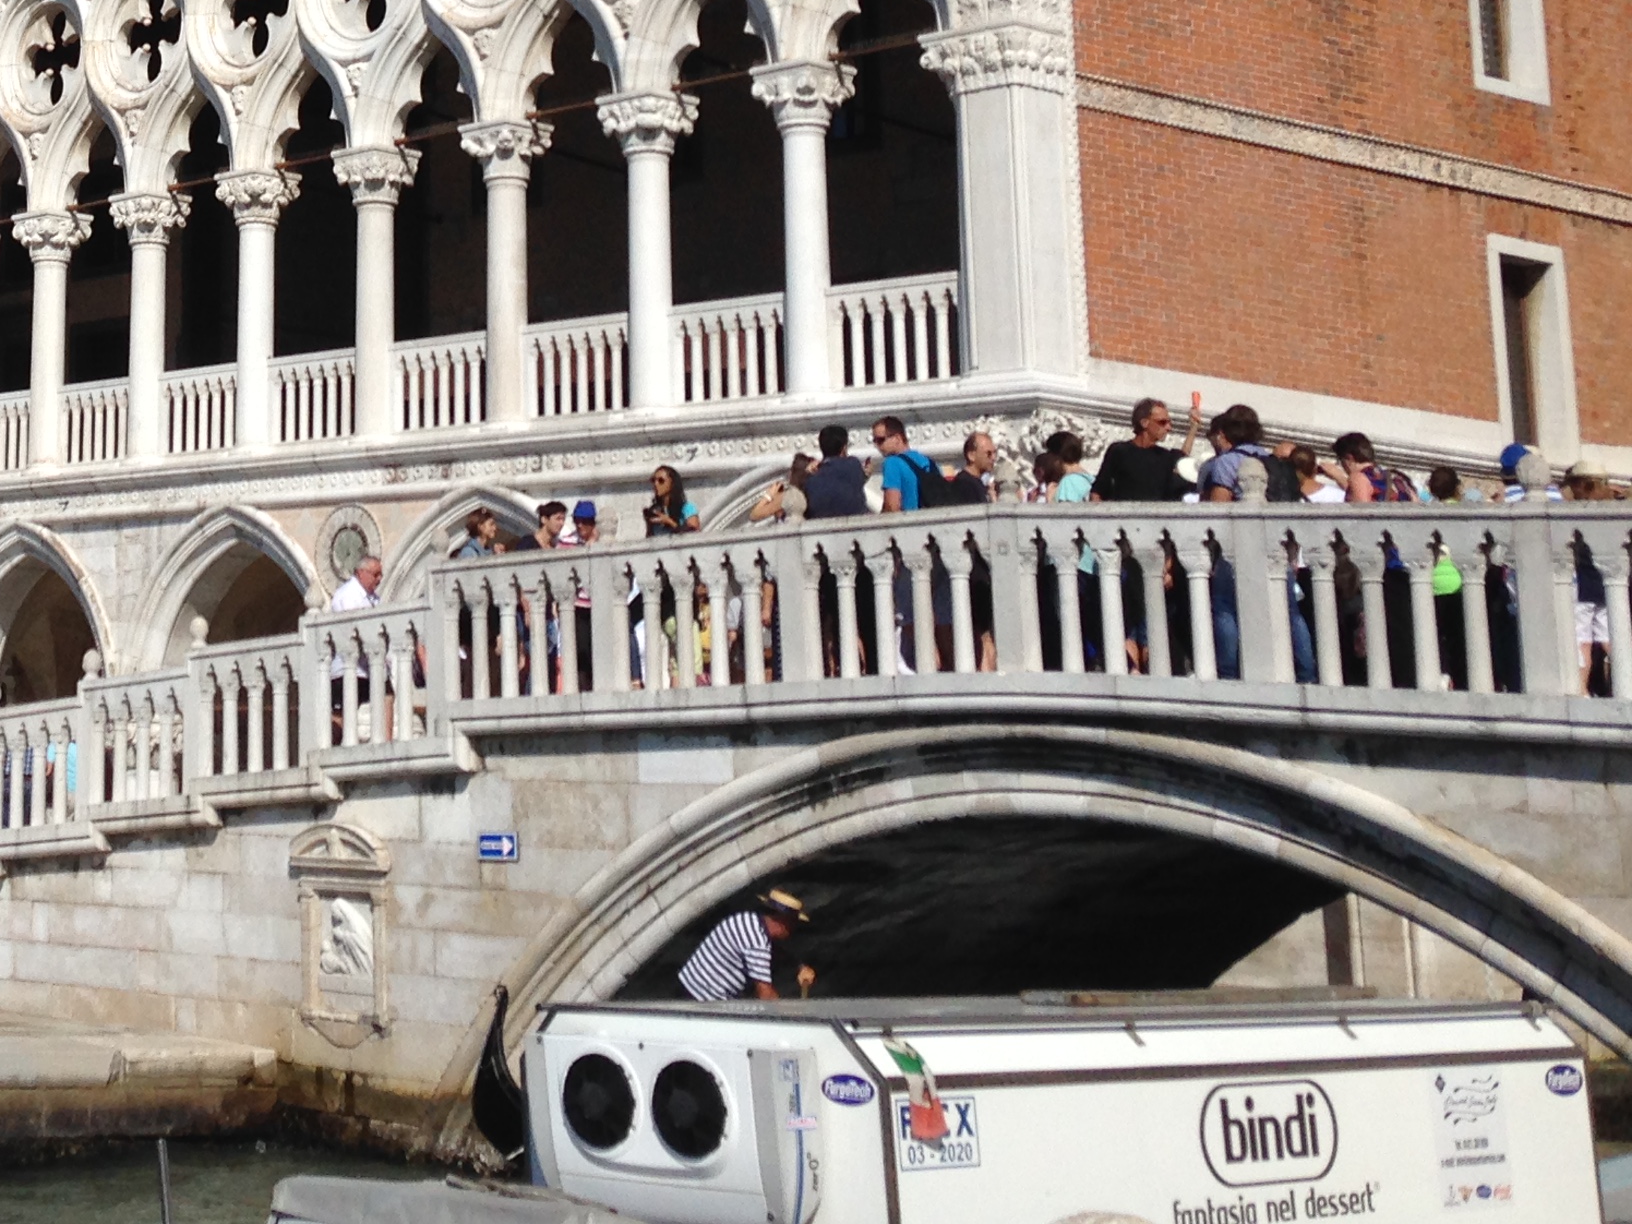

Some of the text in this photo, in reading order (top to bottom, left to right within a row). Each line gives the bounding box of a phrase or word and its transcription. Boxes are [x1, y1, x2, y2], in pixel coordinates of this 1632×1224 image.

[1220, 1092, 1320, 1164] bindi
[1173, 1181, 1376, 1224] fantasia nel dessert
